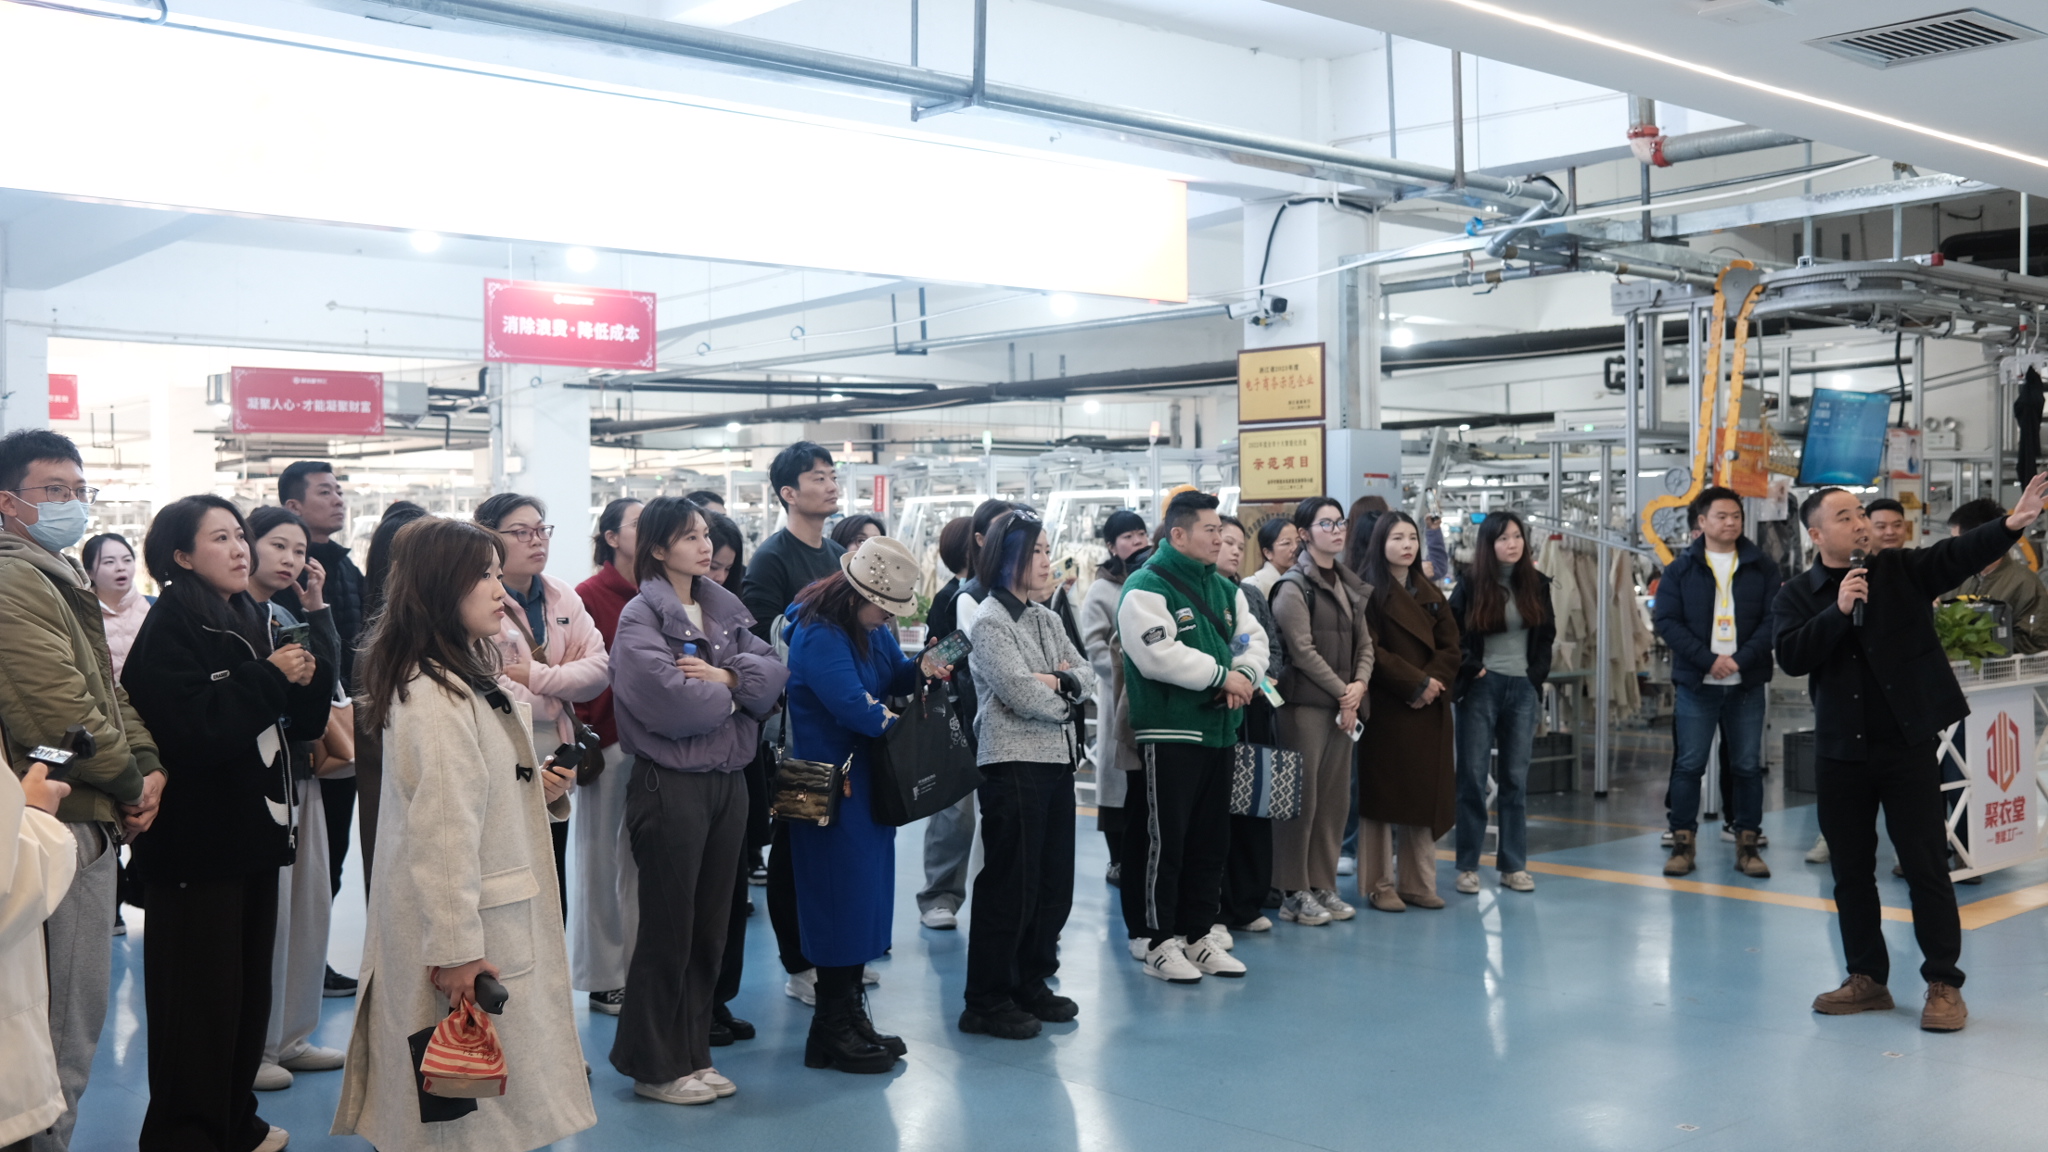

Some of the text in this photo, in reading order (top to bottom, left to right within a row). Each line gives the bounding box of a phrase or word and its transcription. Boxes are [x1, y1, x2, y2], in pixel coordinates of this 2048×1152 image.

[502, 315, 640, 343] 消除浪费·降低成本
[247, 397, 372, 414] 凝聚人心·才能凝聚财富
[1253, 456, 1308, 470] 示范项目
[1984, 796, 2025, 828] 聚衣堂
